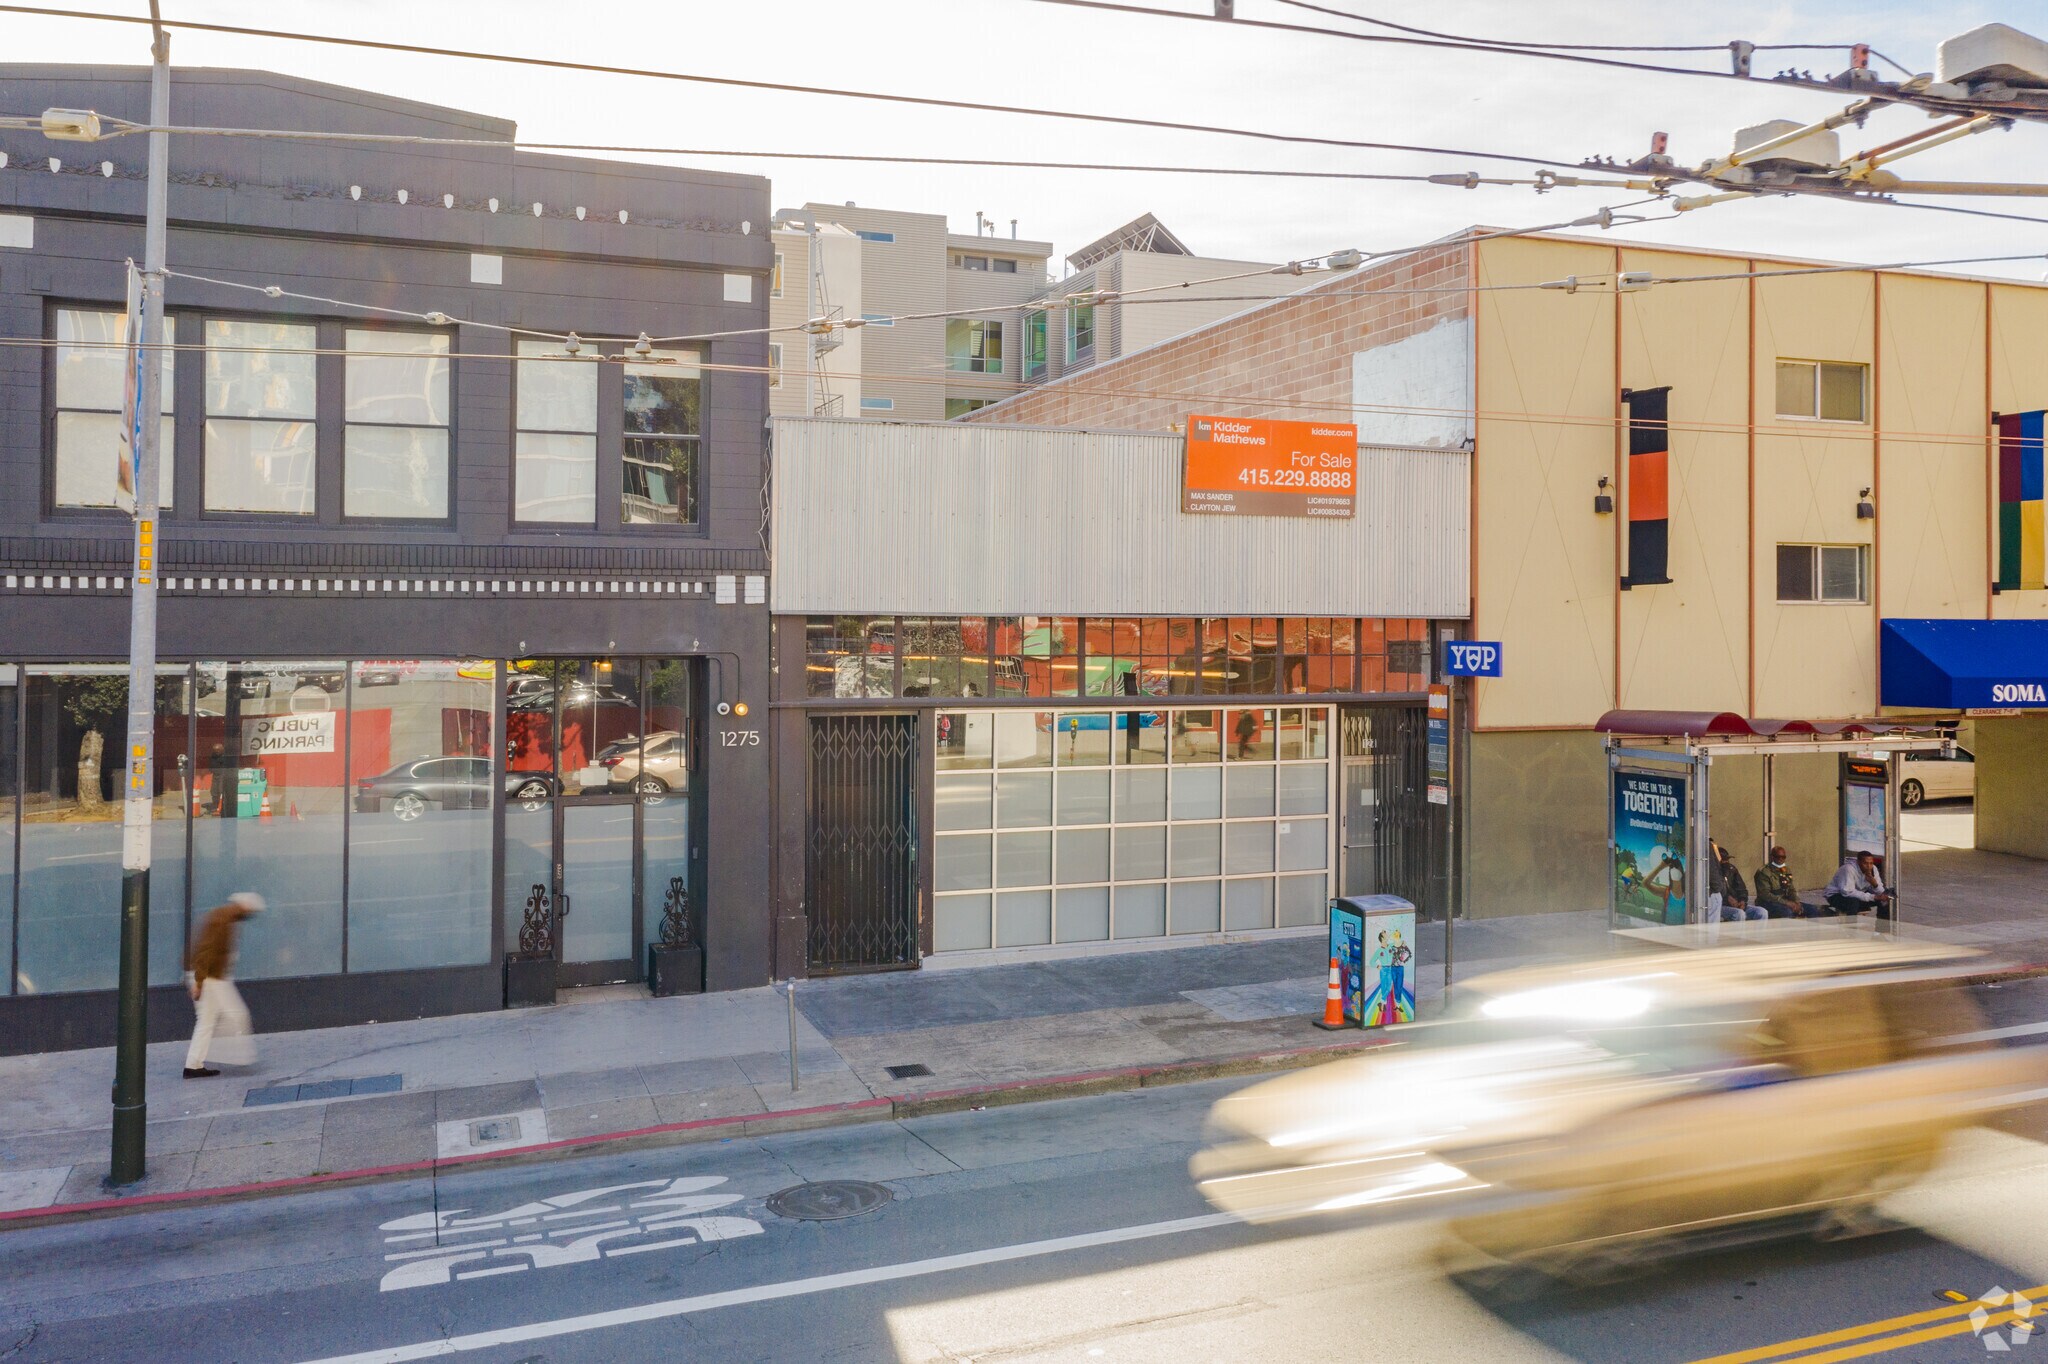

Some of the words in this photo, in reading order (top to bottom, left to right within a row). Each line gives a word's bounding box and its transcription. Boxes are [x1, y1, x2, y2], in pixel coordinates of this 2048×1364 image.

[1214, 421, 1252, 433] Kidder
[1311, 427, 1353, 437] kidder.com
[1213, 433, 1266, 445] Mathews
[1291, 451, 1316, 467] For
[1319, 452, 1352, 468] Sale
[1238, 468, 1352, 488] 415.229.8888
[1190, 492, 1206, 500] MAX
[1206, 493, 1234, 501] SANDER
[1190, 503, 1221, 511] CLAYTON
[1221, 504, 1237, 512] JEW
[1992, 684, 2047, 702] SOMA
[720, 730, 760, 747] 1275
[1627, 780, 1638, 790] WE
[1638, 781, 1649, 792] ARE
[1650, 783, 1658, 793] IN
[1658, 784, 1673, 795] THS
[1622, 790, 1679, 818] TOGETHER
